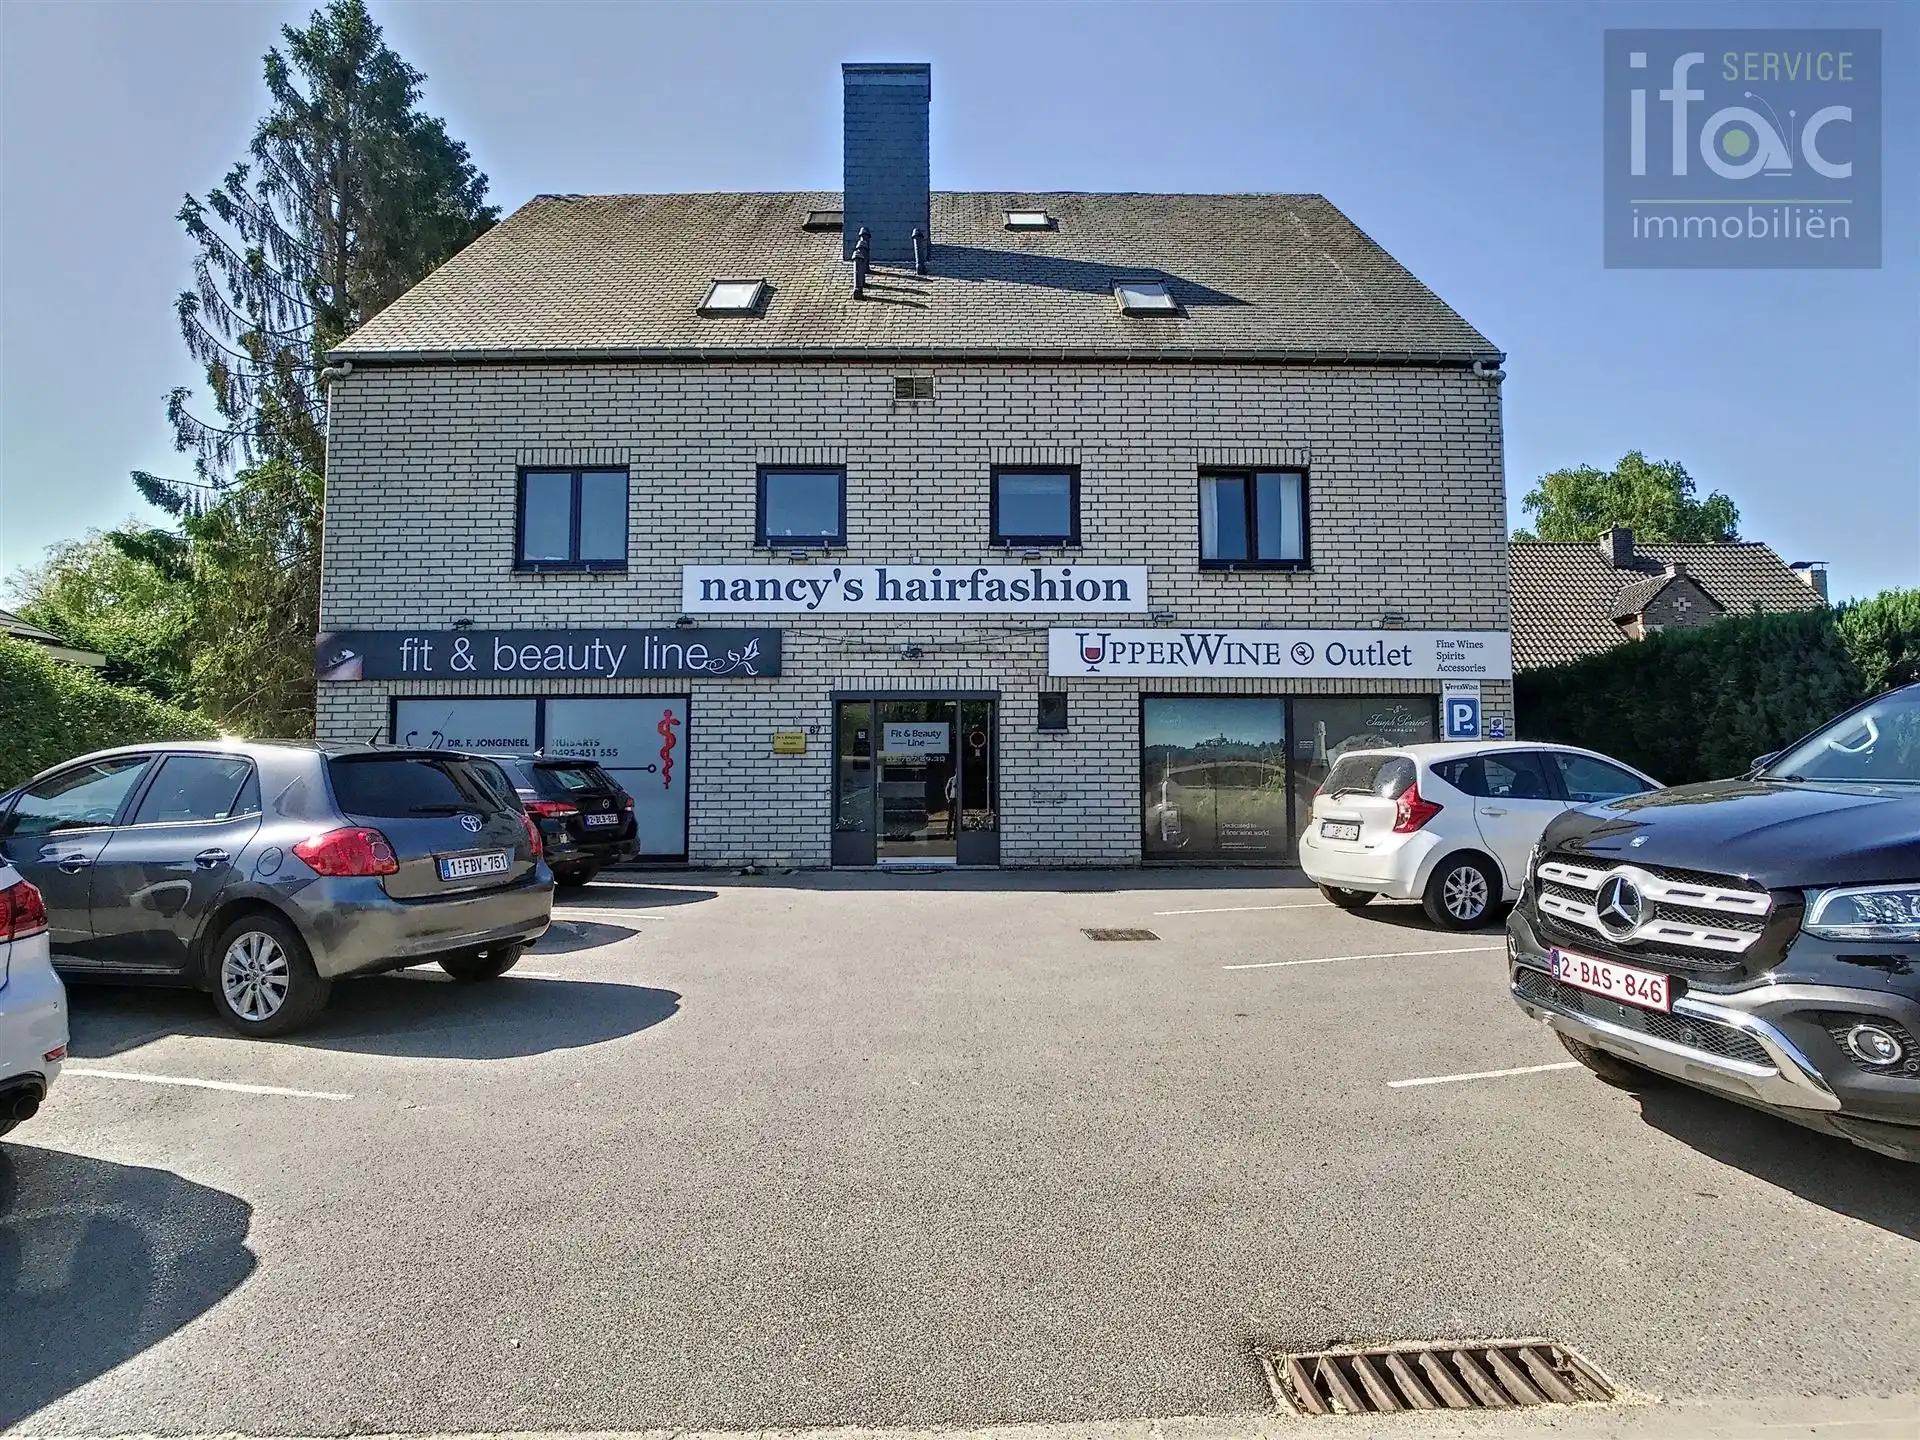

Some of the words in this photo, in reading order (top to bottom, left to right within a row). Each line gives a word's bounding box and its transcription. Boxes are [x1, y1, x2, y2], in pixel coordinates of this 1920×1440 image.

[699, 568, 863, 610] nancy's
[876, 568, 1131, 602] hairfashion
[1436, 640, 1455, 648] Fine
[1457, 640, 1484, 648] Wines
[400, 637, 432, 671] fit
[450, 637, 478, 671] &
[494, 637, 627, 678] beauty
[644, 636, 709, 670] line
[1325, 640, 1413, 667] Outlet
[1436, 652, 1465, 662] Spirits
[1437, 664, 1486, 672] Accessories
[1453, 704, 1473, 732] P
[447, 739, 464, 747] DR.
[466, 739, 473, 747] F.
[475, 739, 530, 747] JONGENEEL
[891, 730, 902, 738] Fit
[903, 730, 910, 738] &
[912, 730, 941, 739] Beauty
[1562, 957, 1662, 1003] 2-BAS-846
